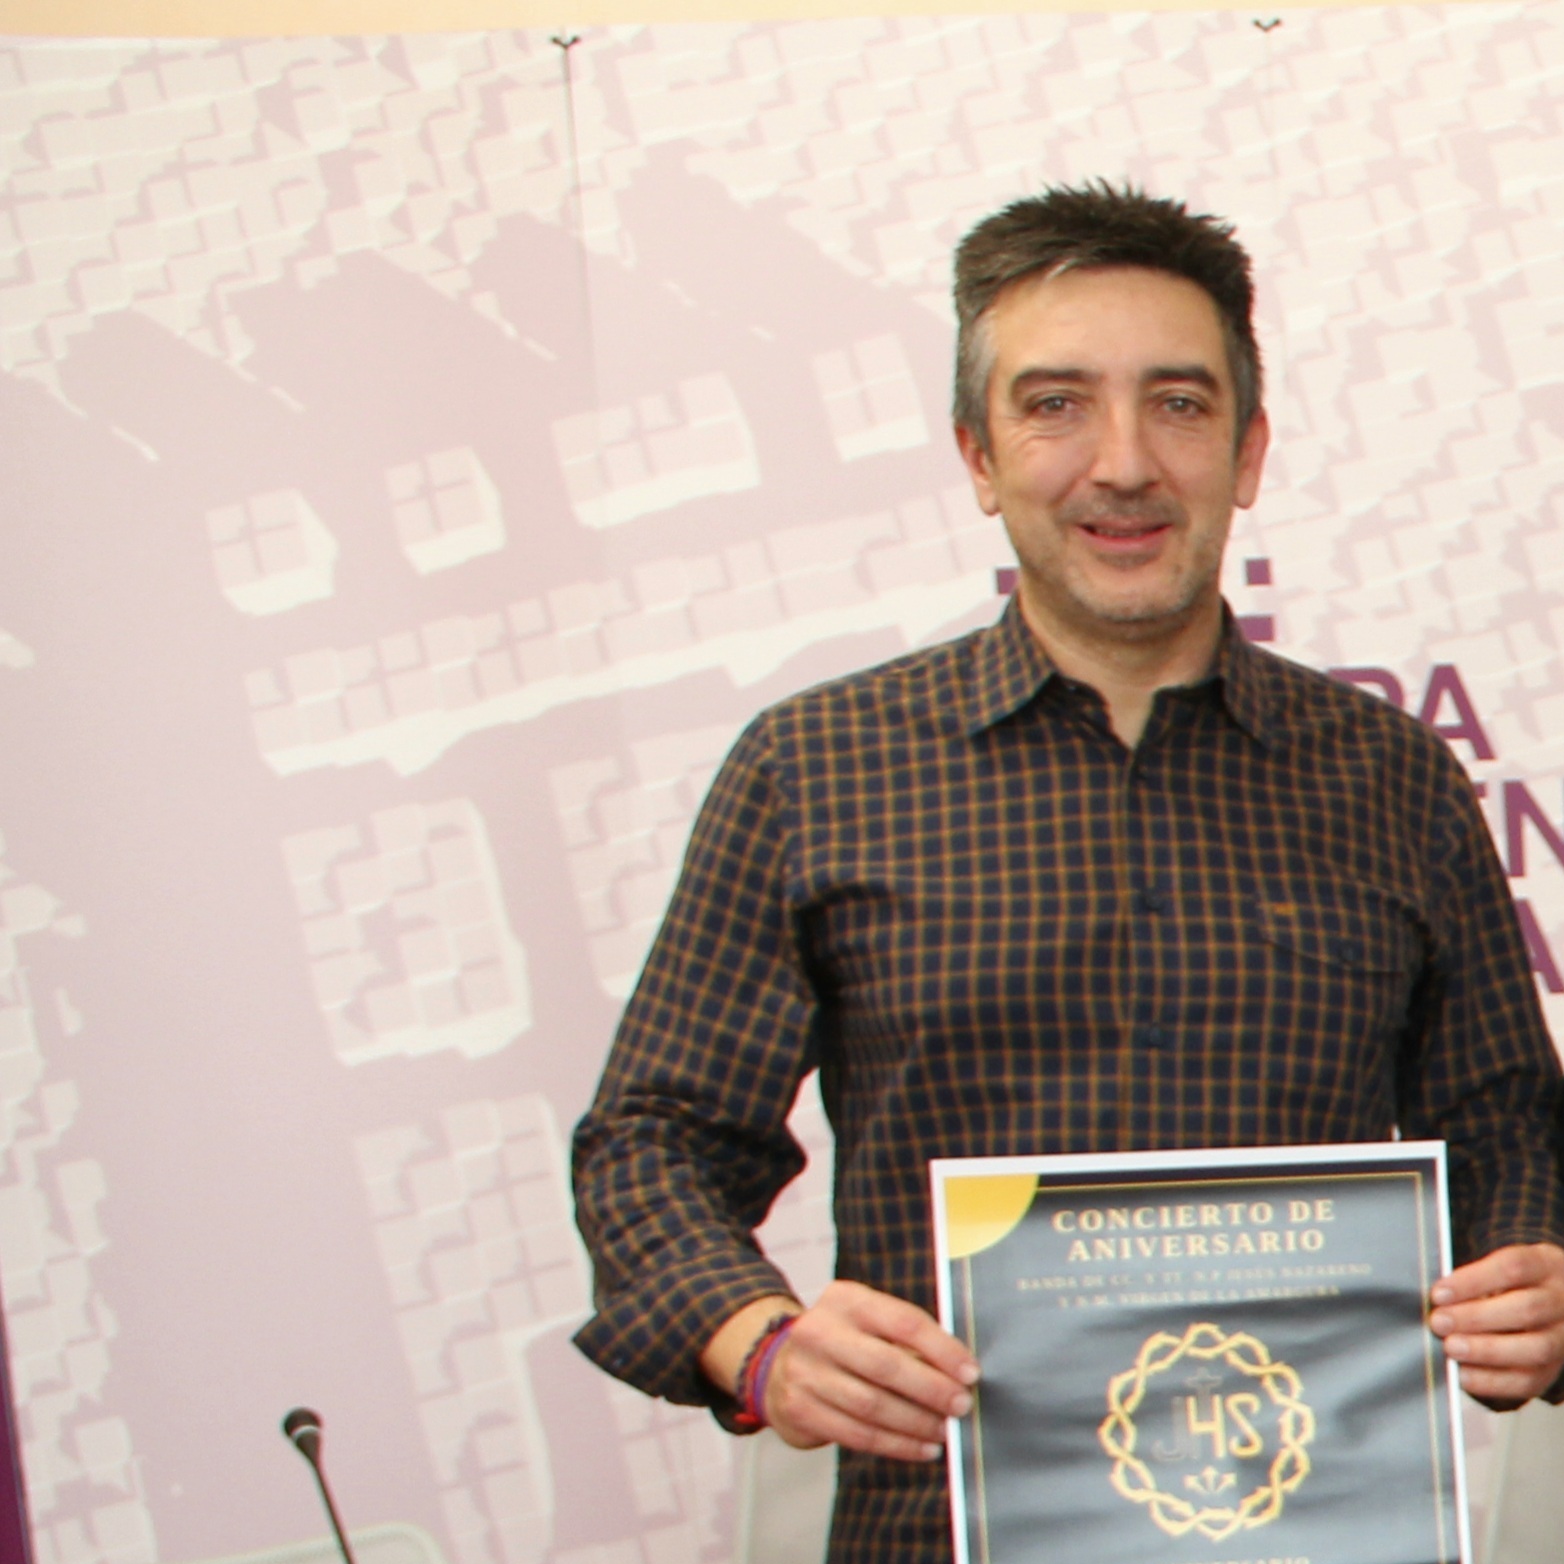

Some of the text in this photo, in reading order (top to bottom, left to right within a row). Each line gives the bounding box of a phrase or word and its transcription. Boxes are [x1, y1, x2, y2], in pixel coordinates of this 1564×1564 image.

[1052, 1199, 1336, 1235] CONCIERTO DE
[1067, 1229, 1325, 1263] ANIVERSARIO
